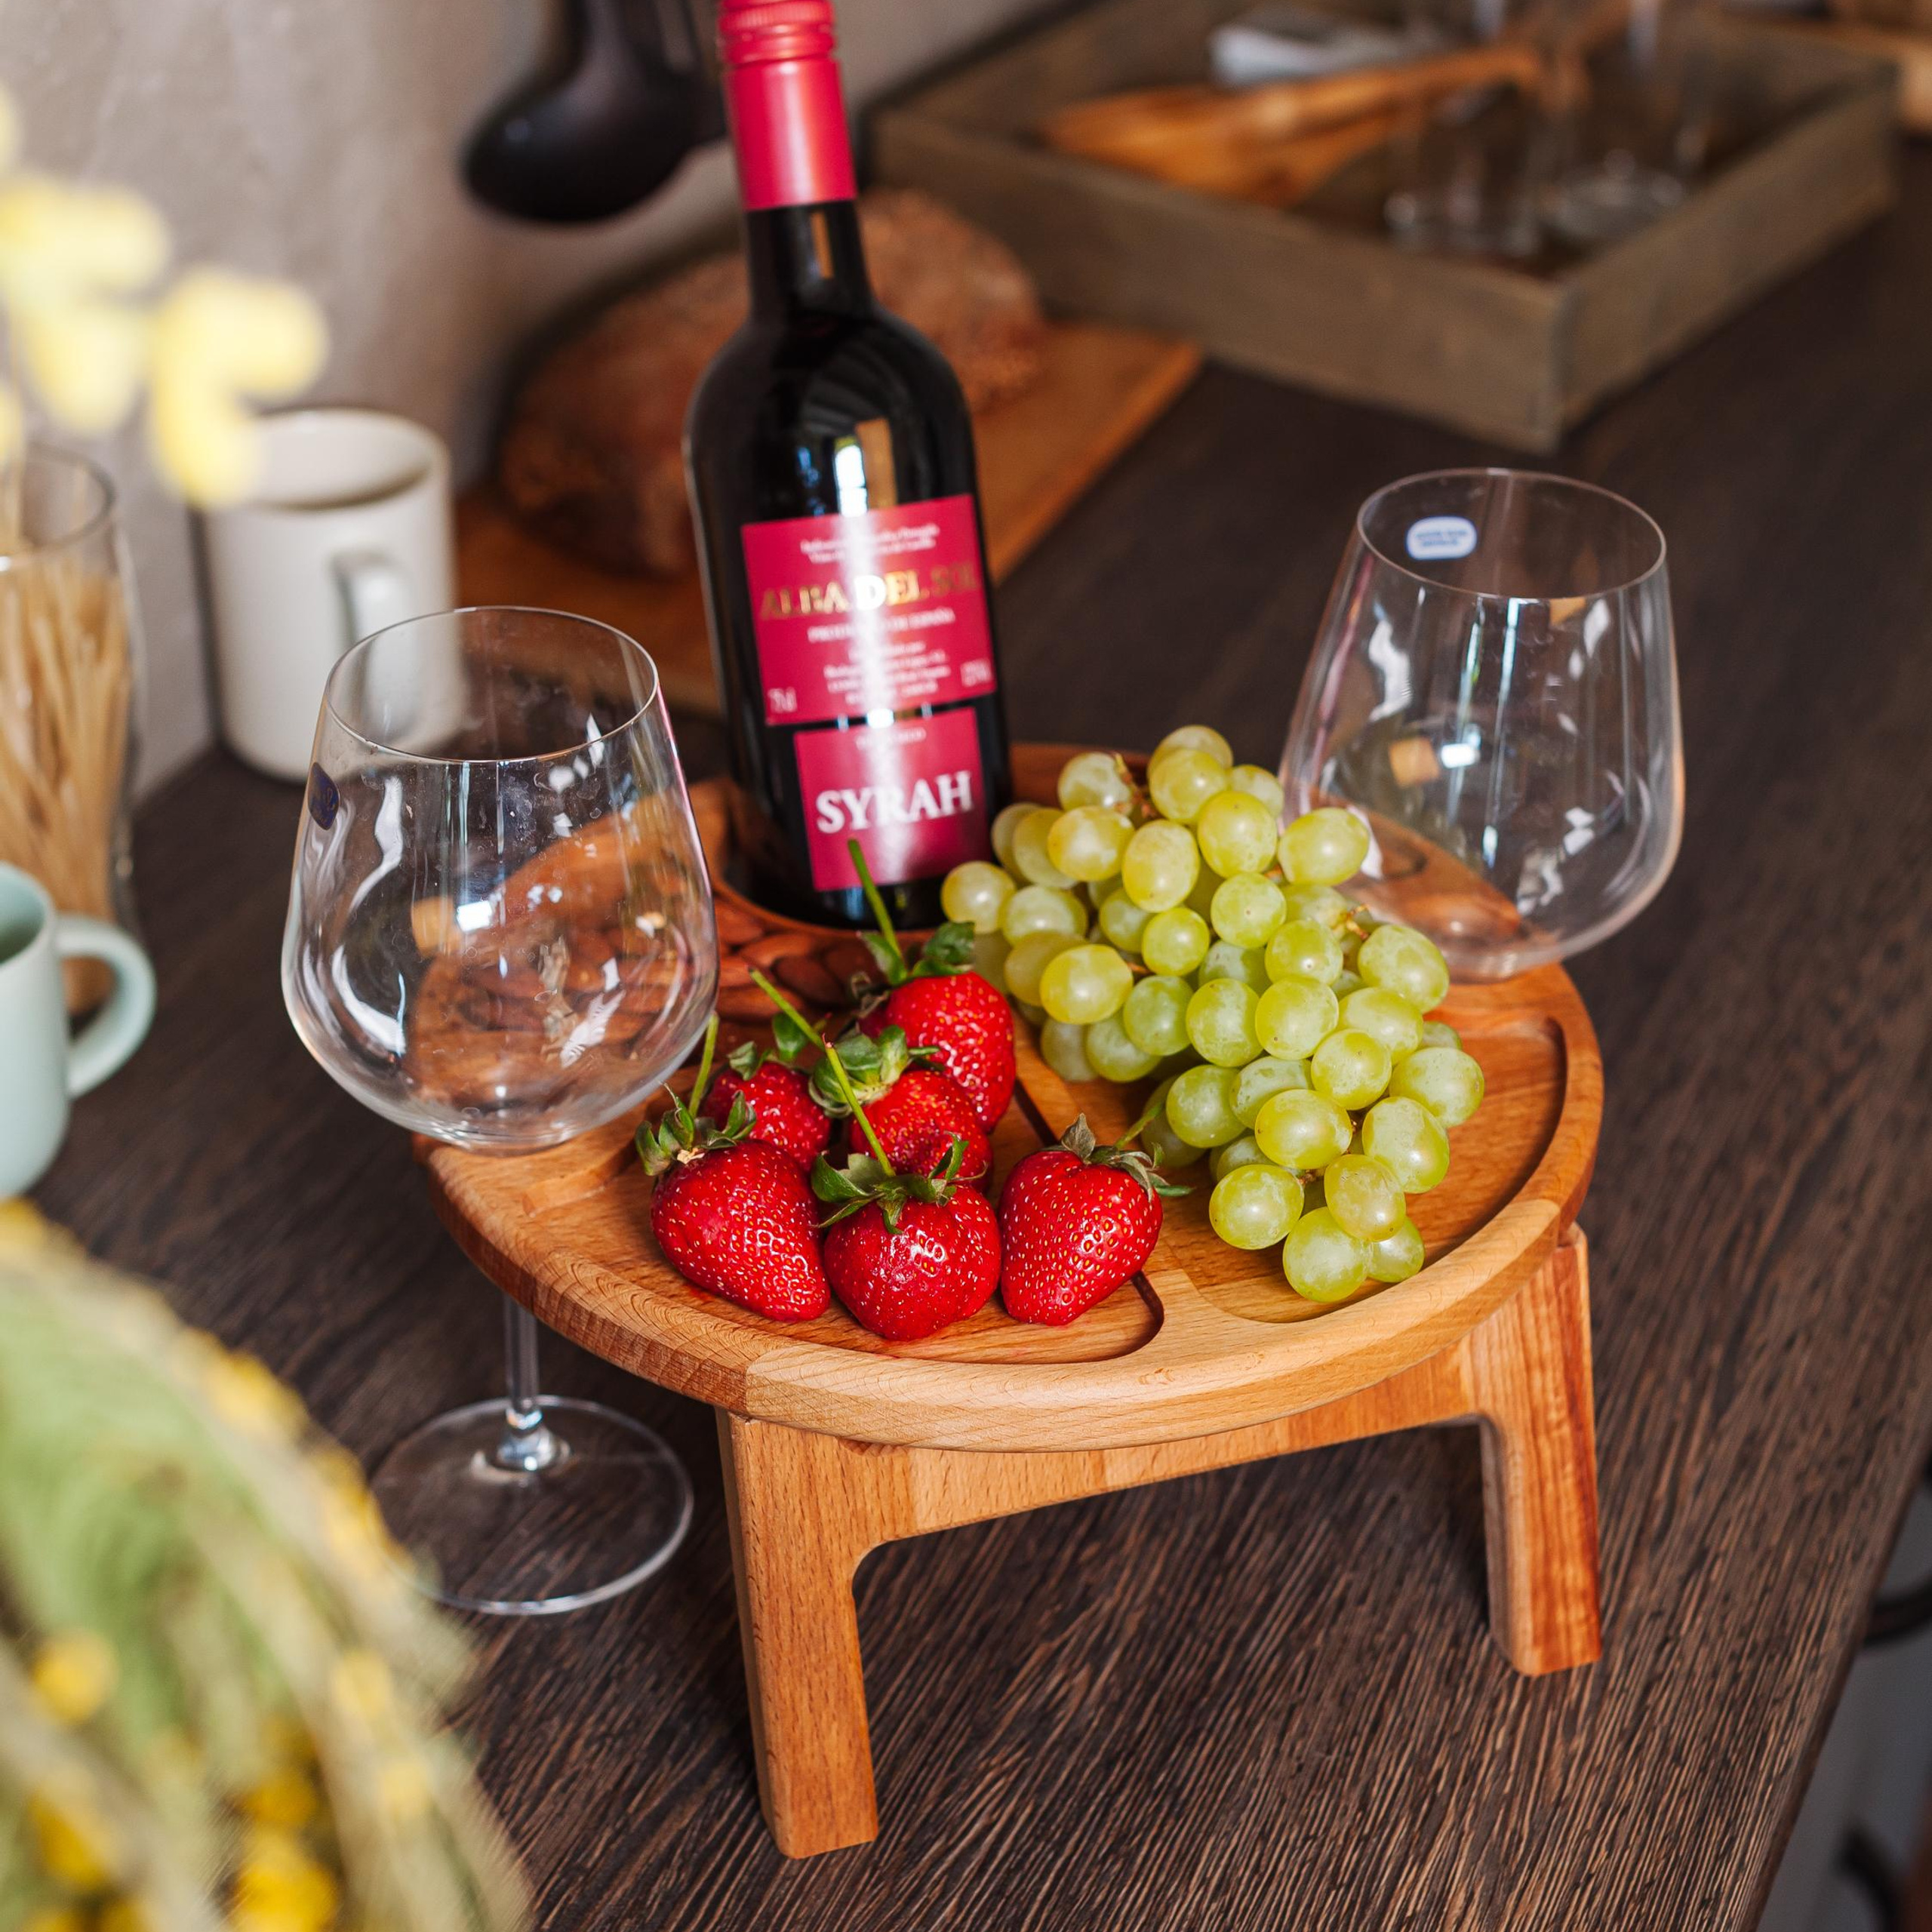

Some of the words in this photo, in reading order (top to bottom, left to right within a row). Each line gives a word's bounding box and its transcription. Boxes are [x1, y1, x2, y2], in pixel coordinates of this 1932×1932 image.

[761, 581, 850, 620] ALBA
[854, 570, 930, 611] DEL
[816, 770, 972, 833] SYRAH
